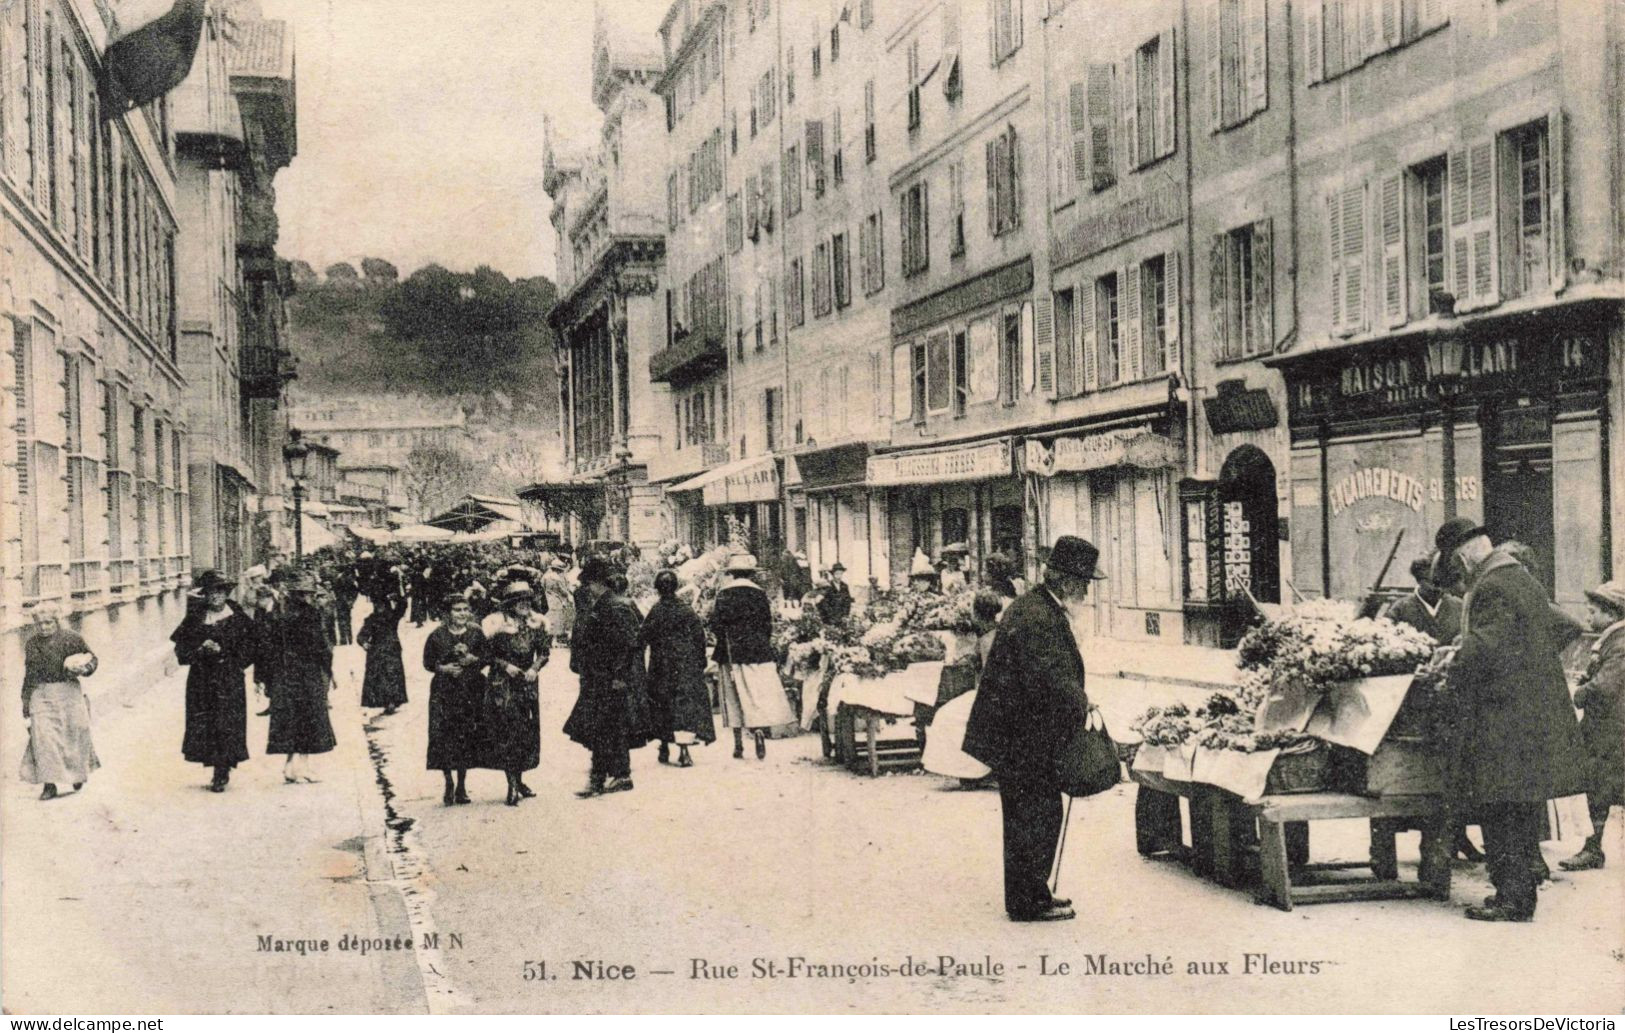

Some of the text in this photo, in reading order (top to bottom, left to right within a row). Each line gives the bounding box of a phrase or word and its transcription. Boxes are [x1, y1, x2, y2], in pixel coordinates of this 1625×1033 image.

[1563, 338, 1584, 367] 14
[1340, 358, 1409, 396] MAISON
[1328, 466, 1425, 517] ENCADREMENTS
[1429, 475, 1478, 501] GLCES
